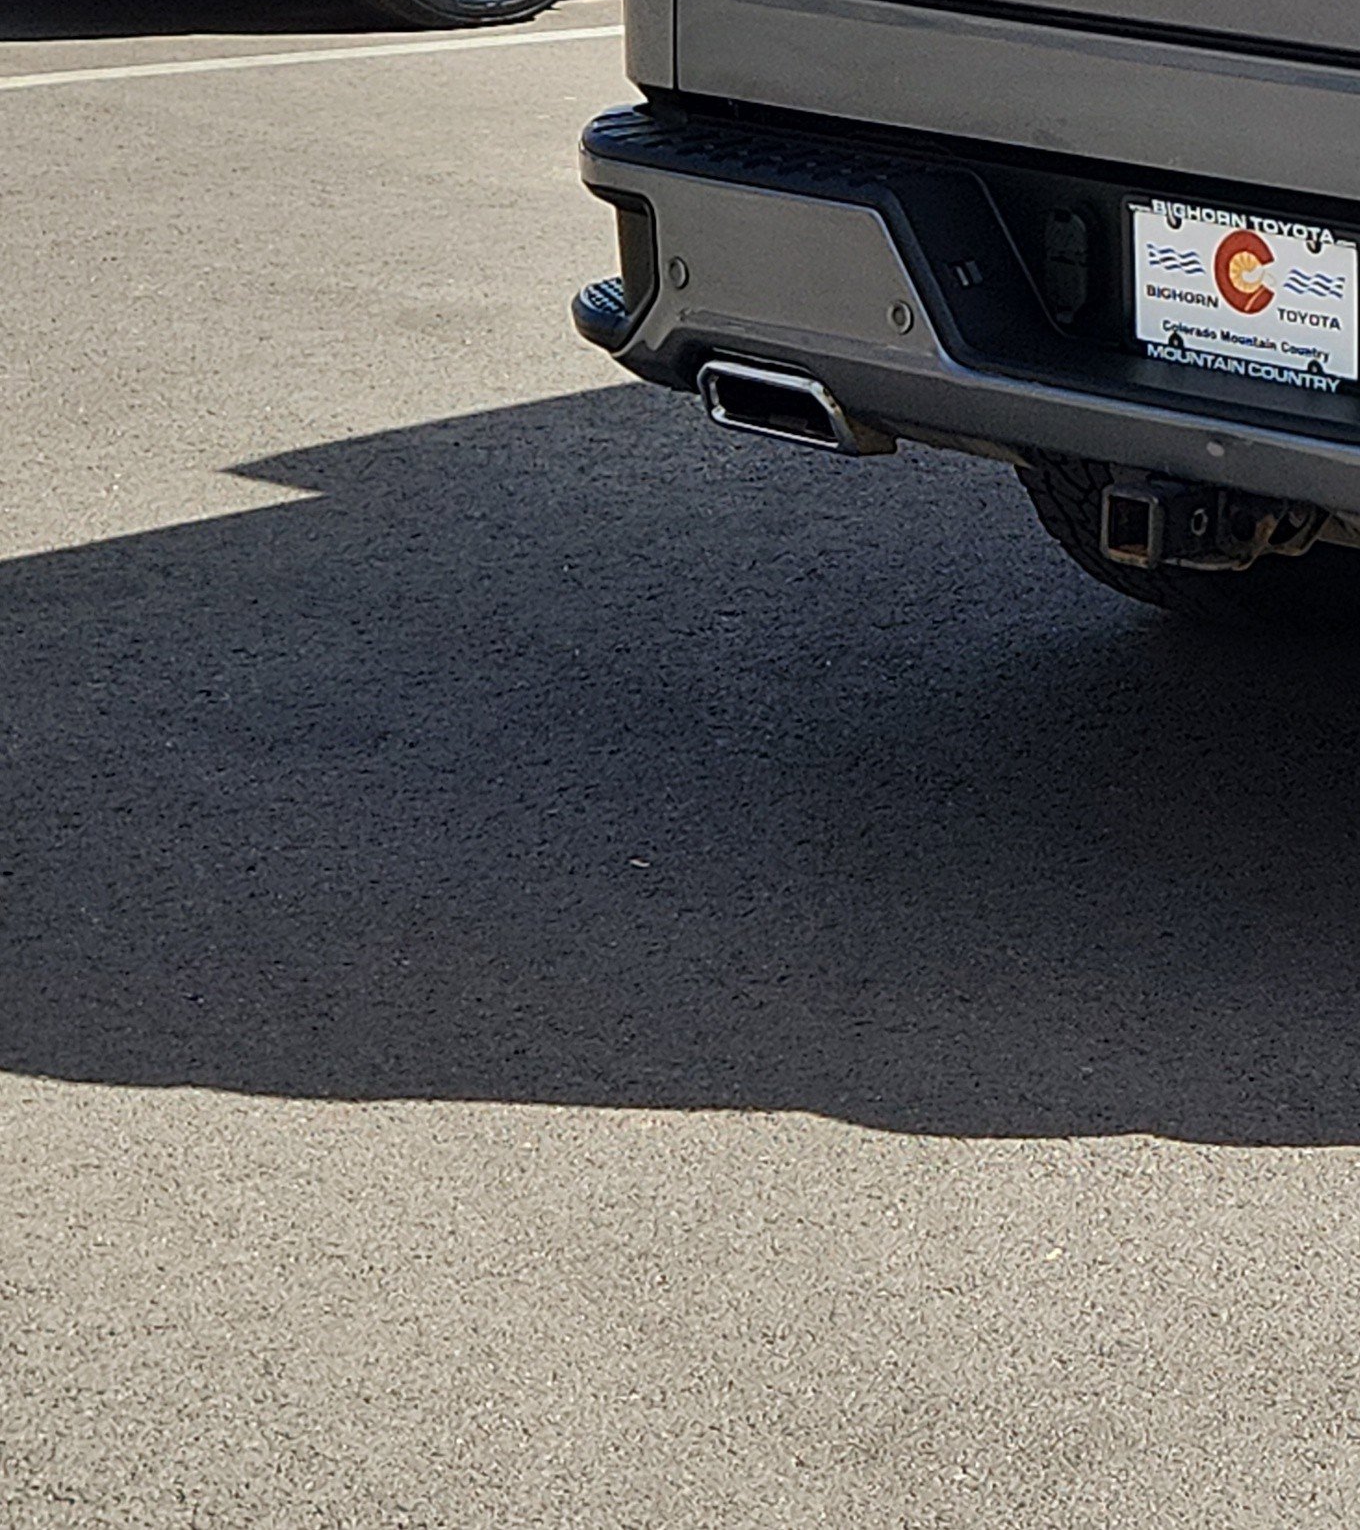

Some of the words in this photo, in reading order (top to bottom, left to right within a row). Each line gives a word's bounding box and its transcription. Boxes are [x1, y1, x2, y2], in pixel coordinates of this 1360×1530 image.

[1151, 198, 1248, 230] BIGHORN
[1250, 216, 1335, 244] TOYOTA
[1145, 284, 1220, 308] BIGHORN
[1277, 307, 1342, 331] TOYOTA
[1162, 320, 1217, 341] Colorado
[1220, 330, 1277, 351] Mountain
[1281, 341, 1331, 363] Country
[1147, 343, 1246, 375] MOUNTAIN
[1248, 364, 1342, 393] COUNTRY
